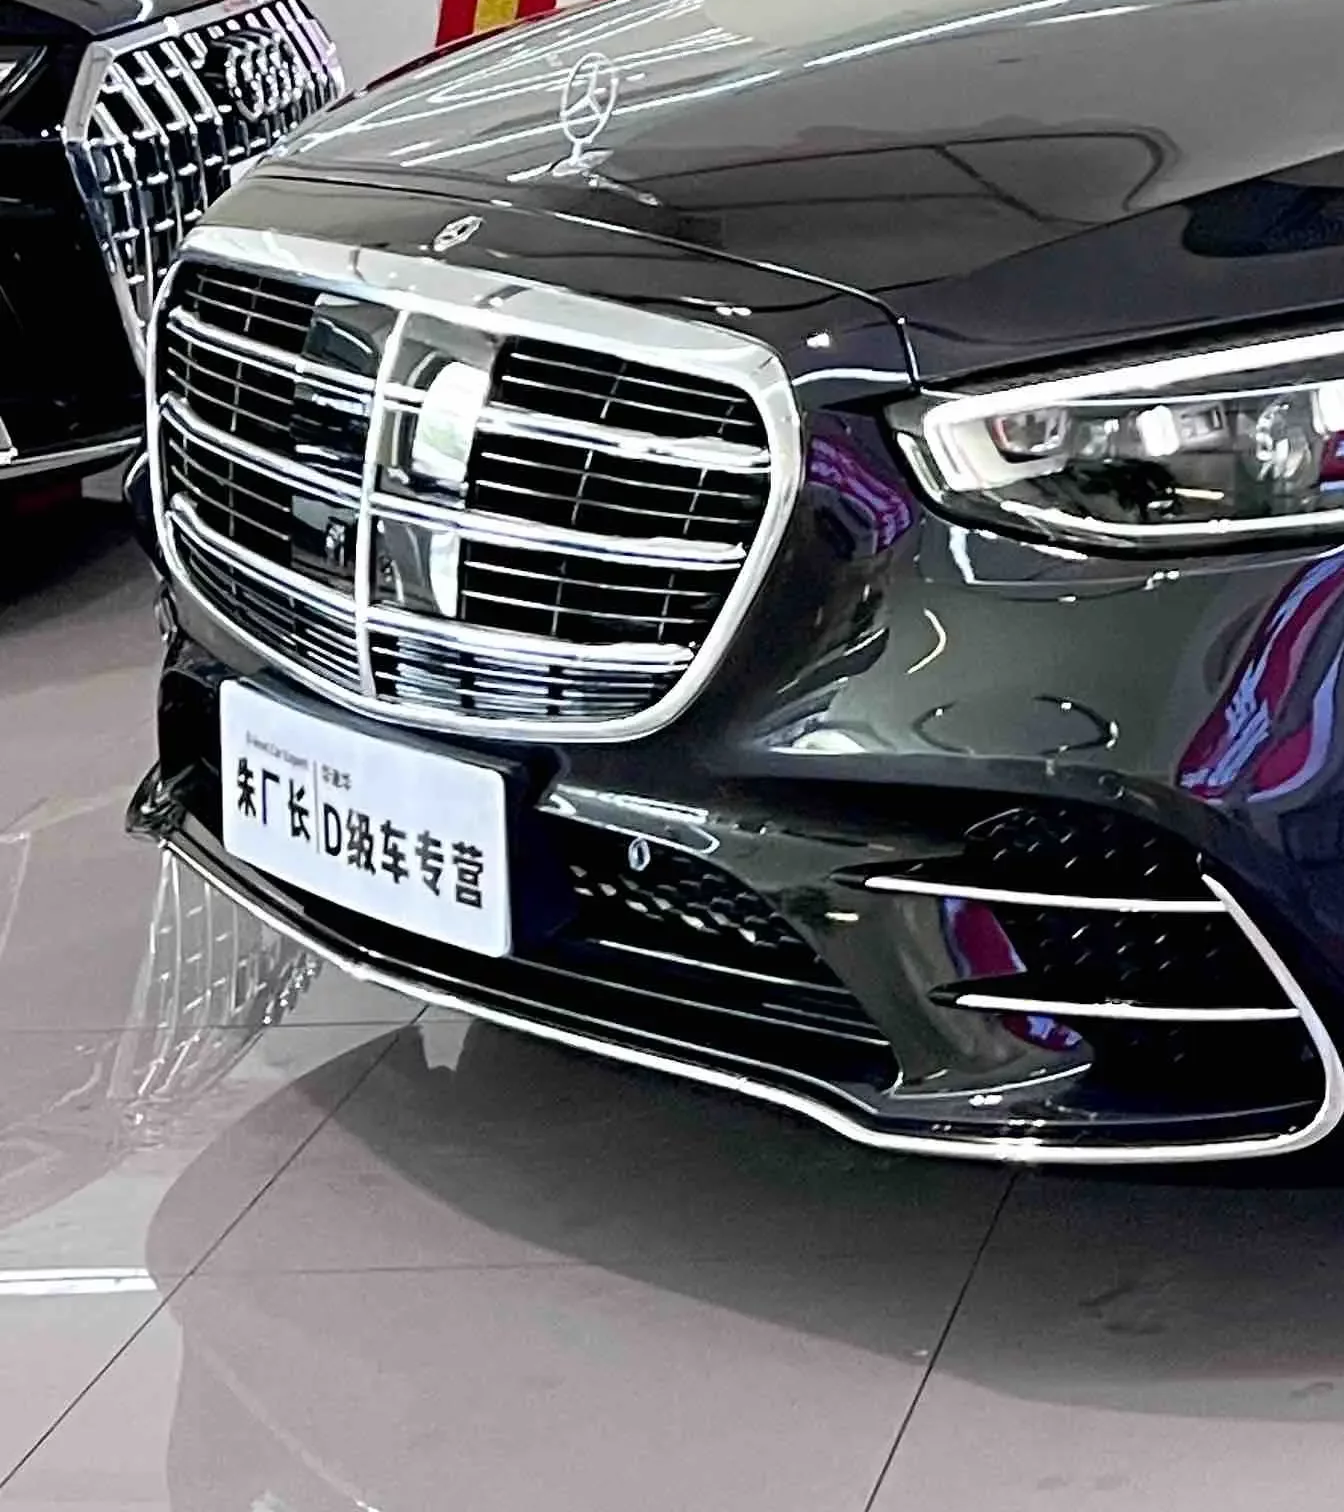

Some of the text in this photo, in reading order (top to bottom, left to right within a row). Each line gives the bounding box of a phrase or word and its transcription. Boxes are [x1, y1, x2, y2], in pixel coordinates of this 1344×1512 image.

[237, 757, 484, 909] 朱厂长 D级车专营
